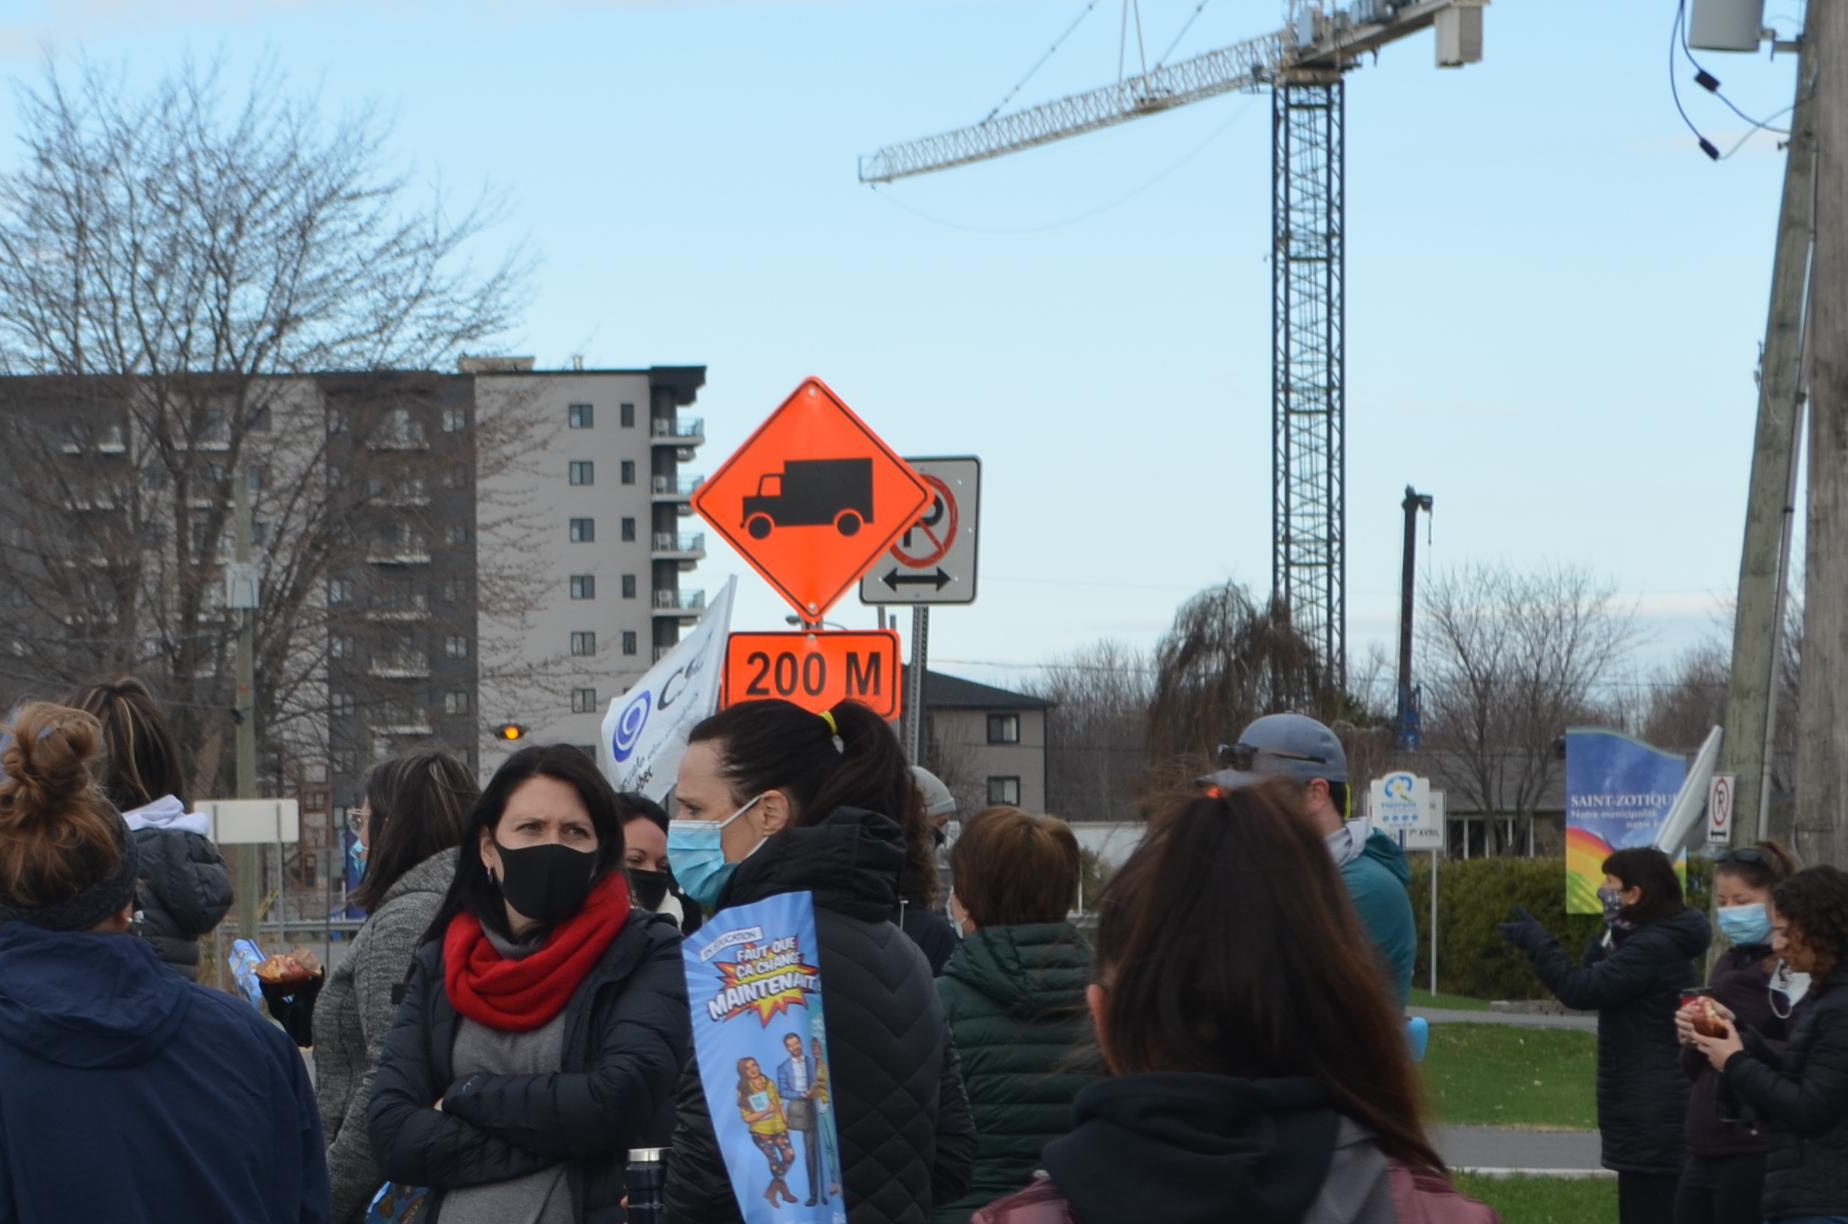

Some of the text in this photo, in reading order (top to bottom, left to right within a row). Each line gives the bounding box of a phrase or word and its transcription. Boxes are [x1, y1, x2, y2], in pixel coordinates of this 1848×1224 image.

[745, 652, 826, 697] 200
[845, 652, 881, 696] M
[1419, 829, 1439, 837] AVRIL
[736, 936, 797, 962] FAUT QUE
